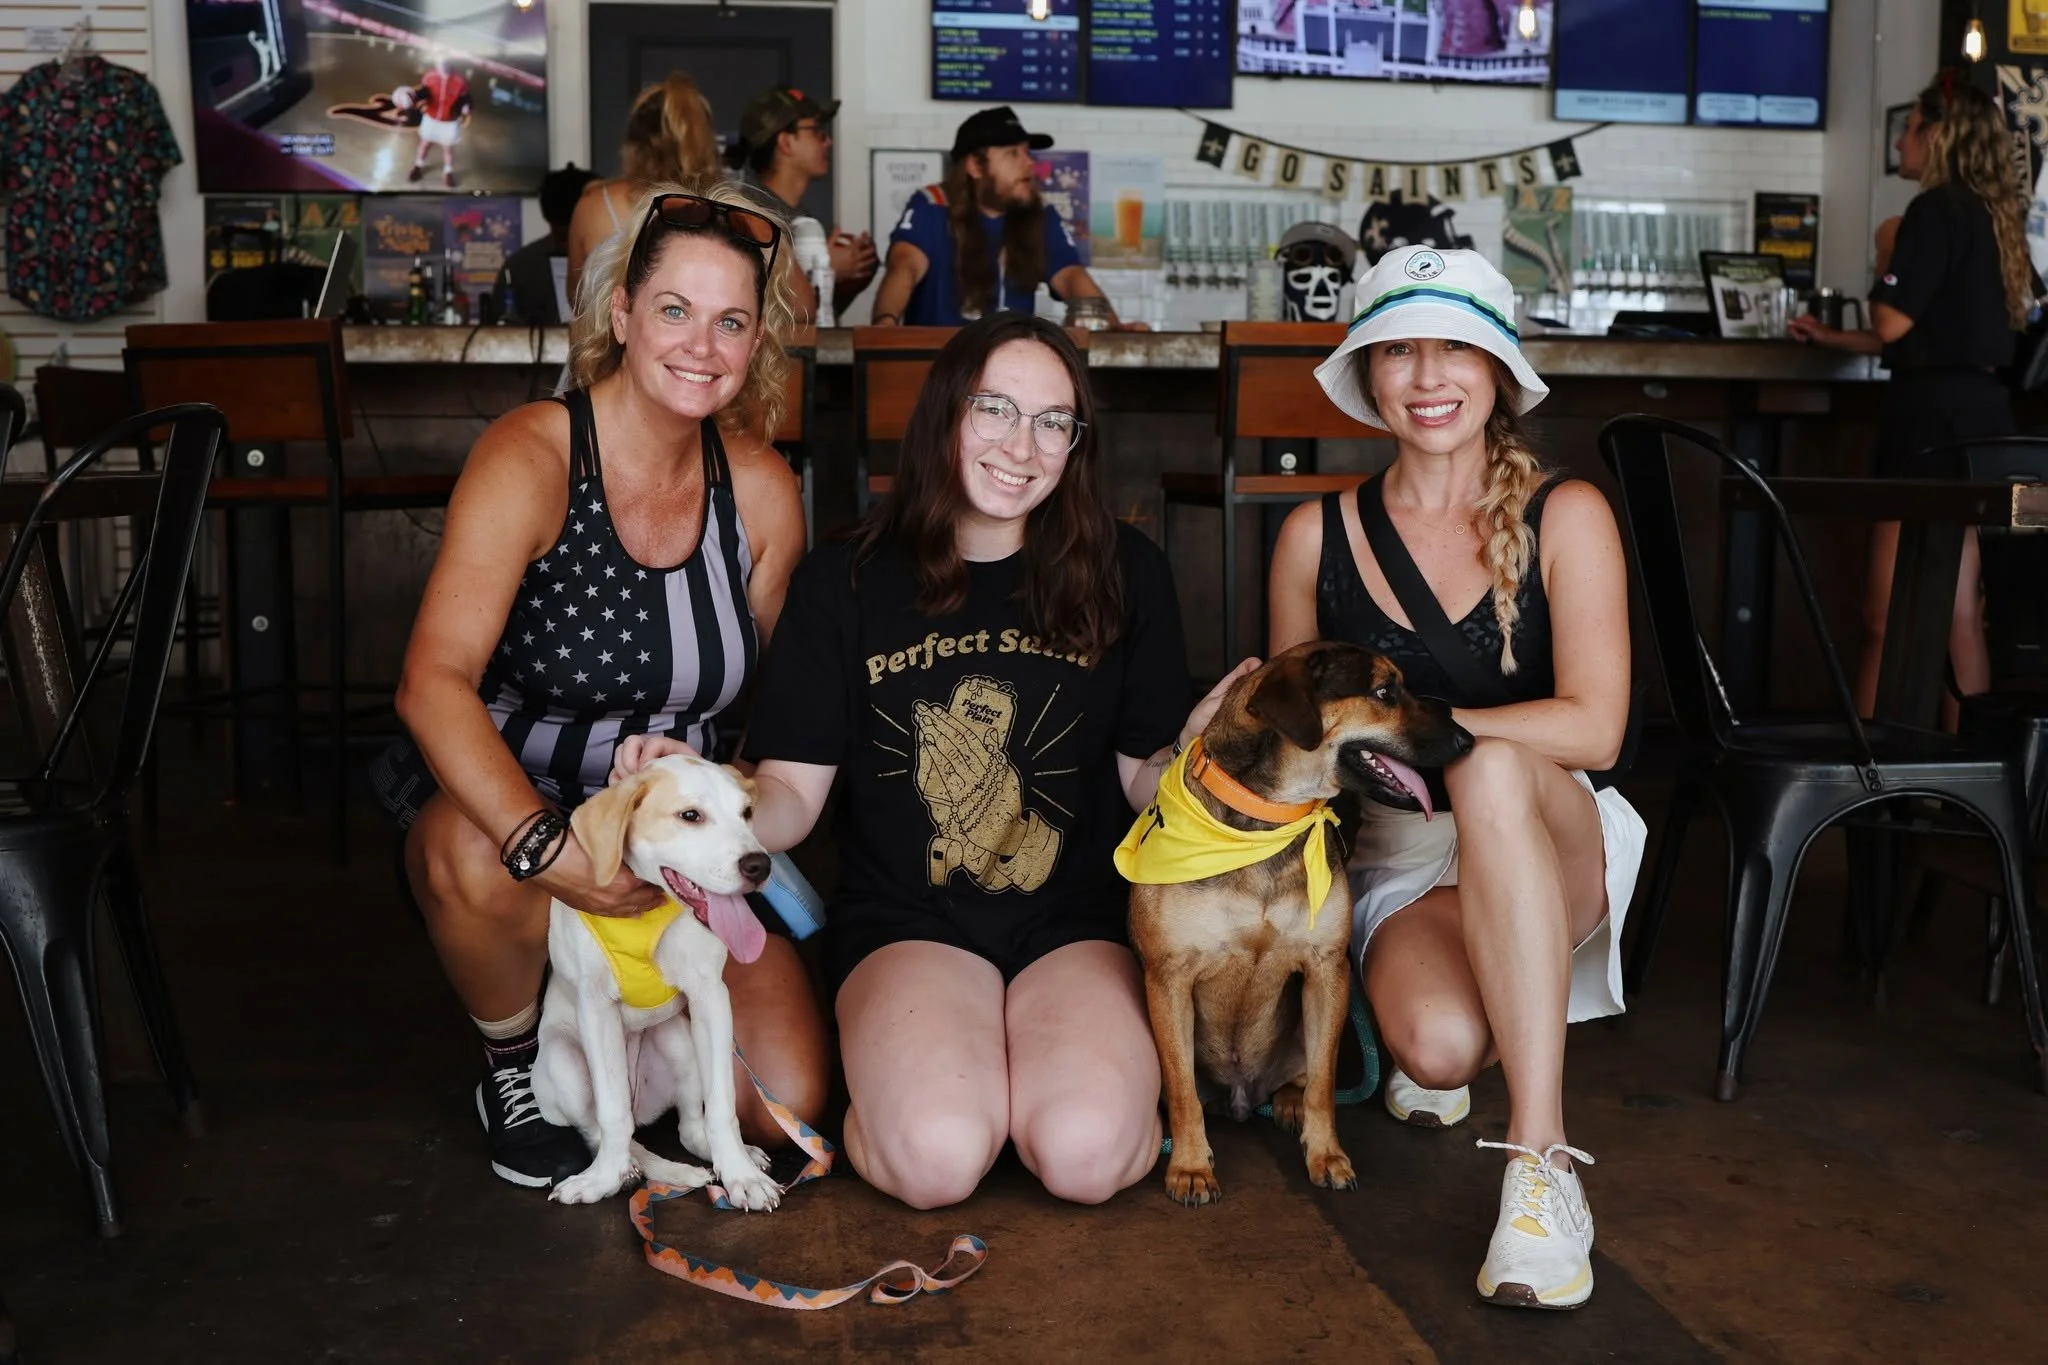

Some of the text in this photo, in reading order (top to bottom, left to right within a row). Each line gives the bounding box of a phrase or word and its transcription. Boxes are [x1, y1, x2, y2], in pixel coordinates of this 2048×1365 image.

[1241, 145, 1536, 197] GO SAINTS
[1409, 270, 1438, 279] PICKLE
[866, 629, 990, 684] Perfect
[962, 698, 1003, 719] Perfect
[964, 708, 994, 725] Plain
